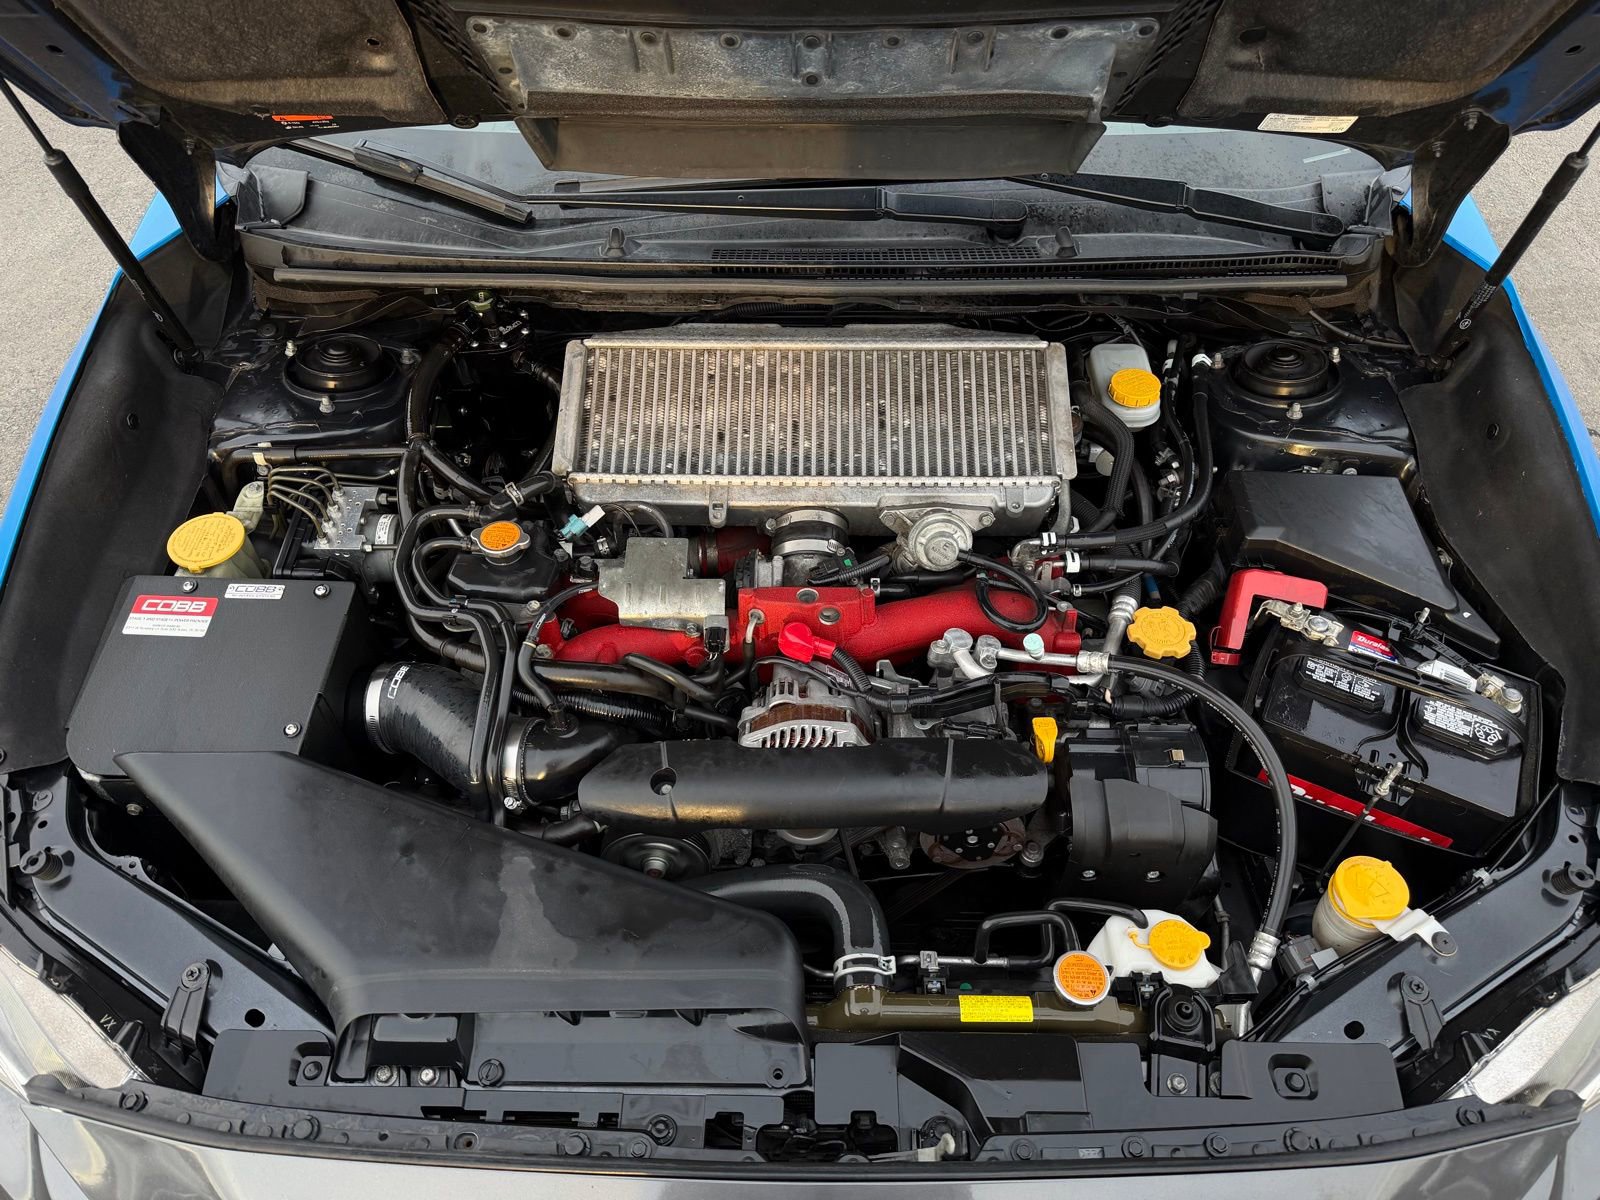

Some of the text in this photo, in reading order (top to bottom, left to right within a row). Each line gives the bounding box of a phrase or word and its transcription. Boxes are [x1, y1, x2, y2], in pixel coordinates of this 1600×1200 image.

[235, 585, 276, 593] COBB
[141, 599, 207, 613] COBB
[1357, 635, 1391, 652] Duralas
